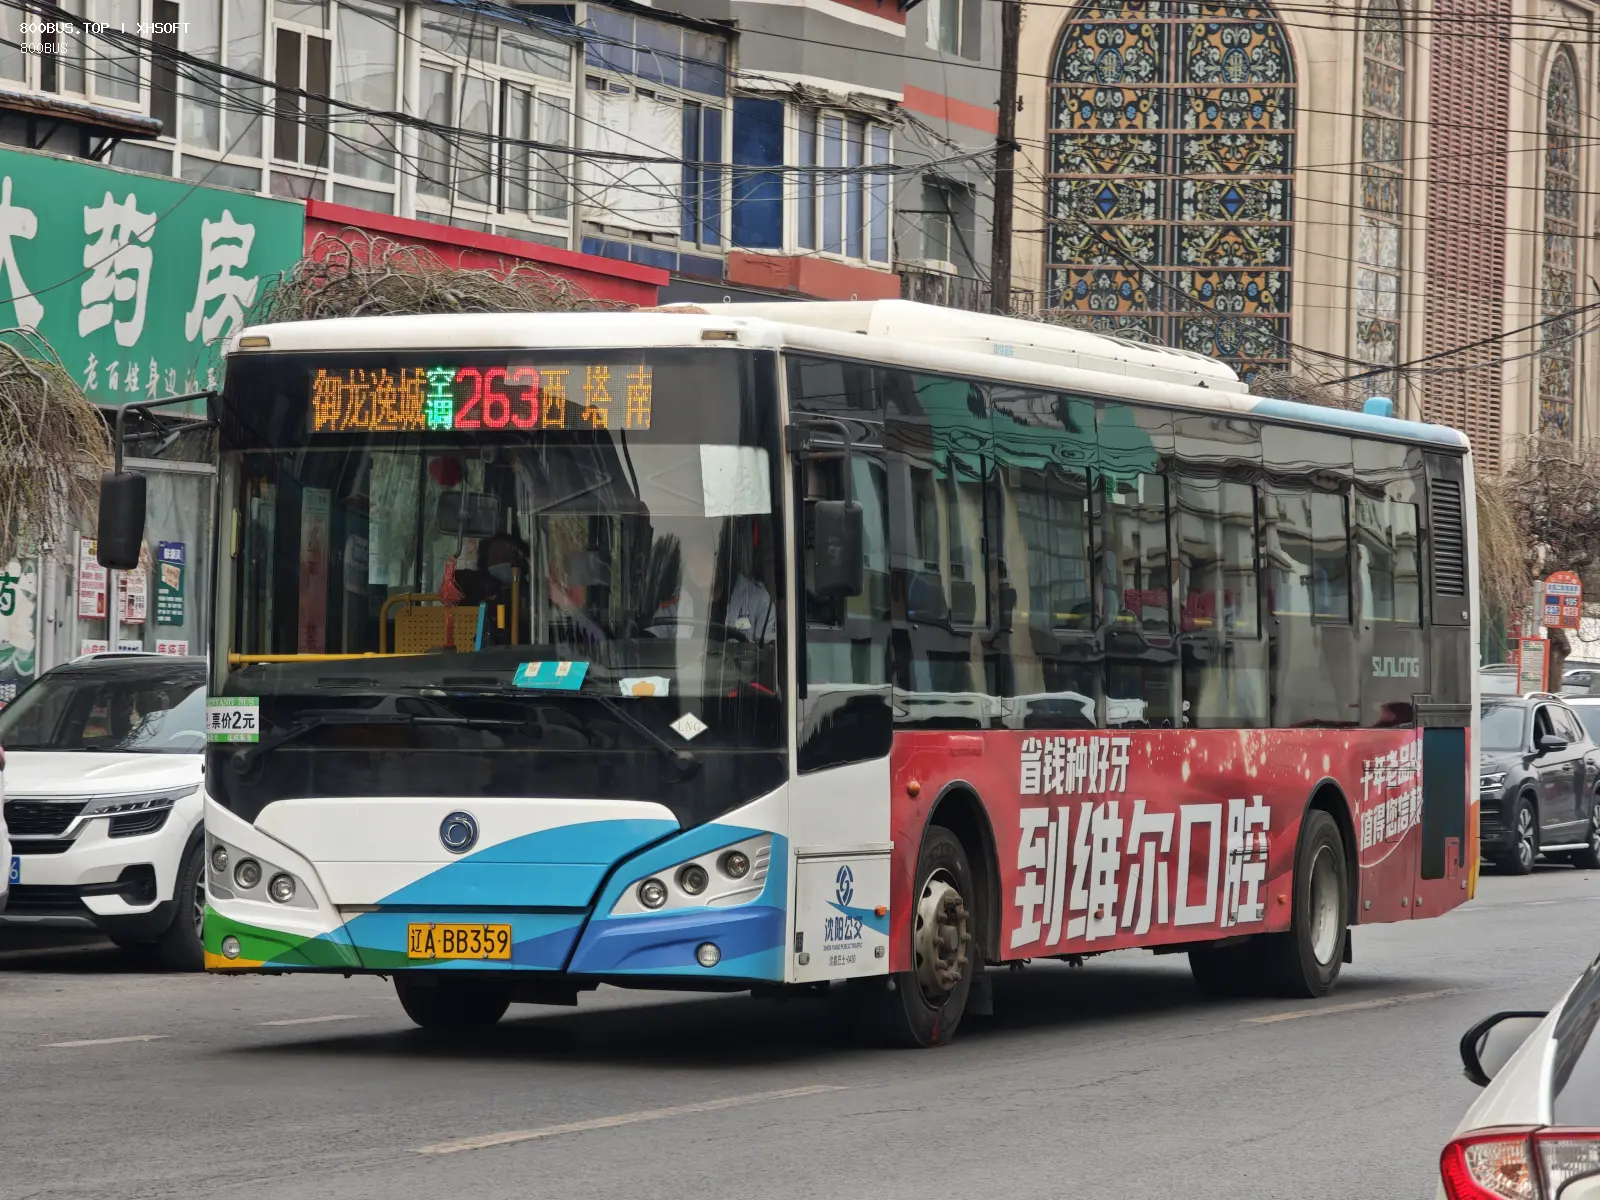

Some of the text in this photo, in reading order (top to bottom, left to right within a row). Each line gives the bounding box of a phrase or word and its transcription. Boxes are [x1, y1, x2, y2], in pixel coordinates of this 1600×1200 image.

[455, 367, 539, 429] 263
[541, 365, 652, 430] 西塔南
[1372, 656, 1420, 678] SUNLONG
[212, 711, 255, 729] 票价2元
[1020, 736, 1131, 796] 省钱种好牙
[1010, 795, 1271, 949] 到维尔口腔
[825, 916, 863, 942] 沈阳公交
